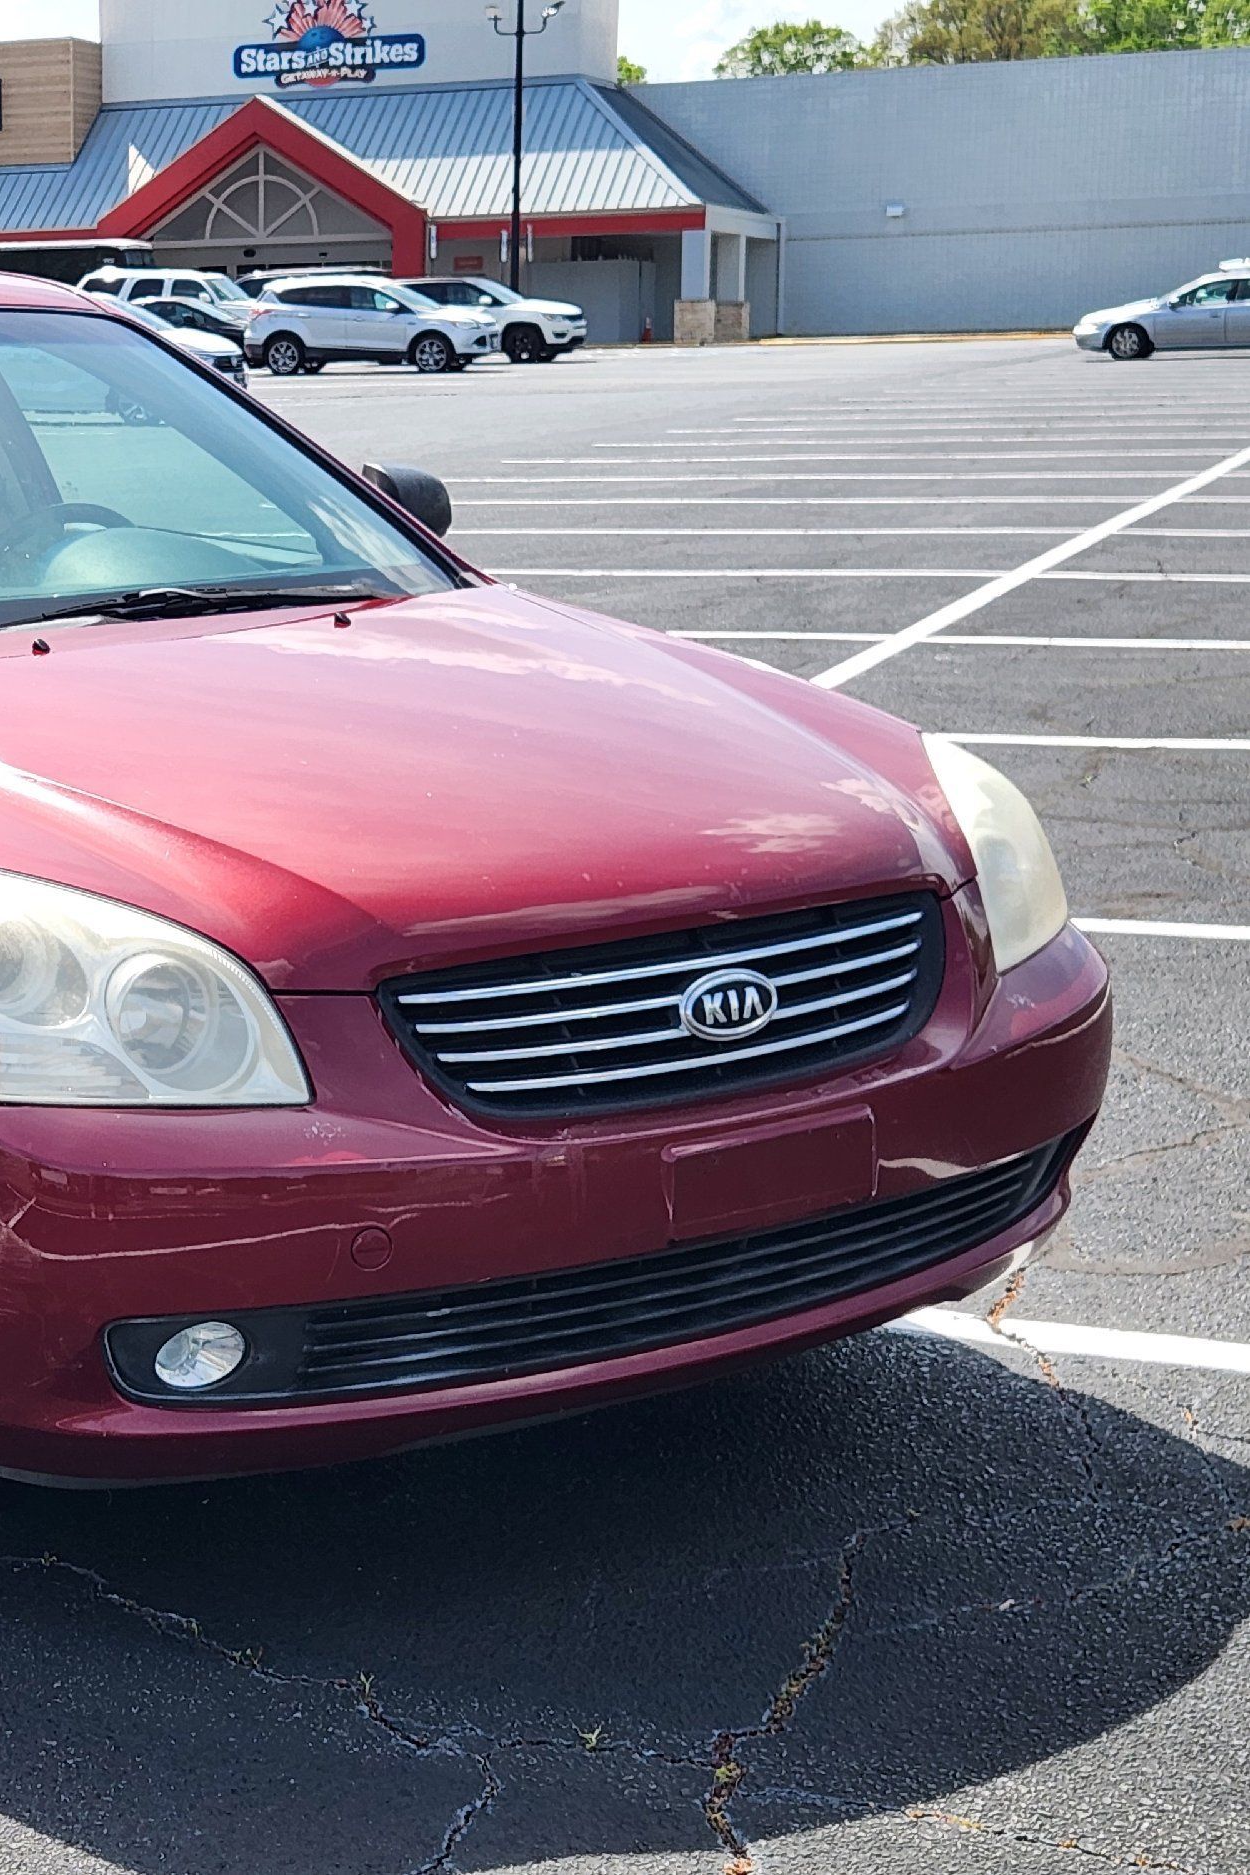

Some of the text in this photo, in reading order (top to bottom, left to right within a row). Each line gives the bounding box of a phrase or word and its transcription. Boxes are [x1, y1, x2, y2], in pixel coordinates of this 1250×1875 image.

[241, 49, 306, 73] Stars
[329, 40, 418, 66] Strikes
[701, 985, 764, 1025] KIA
